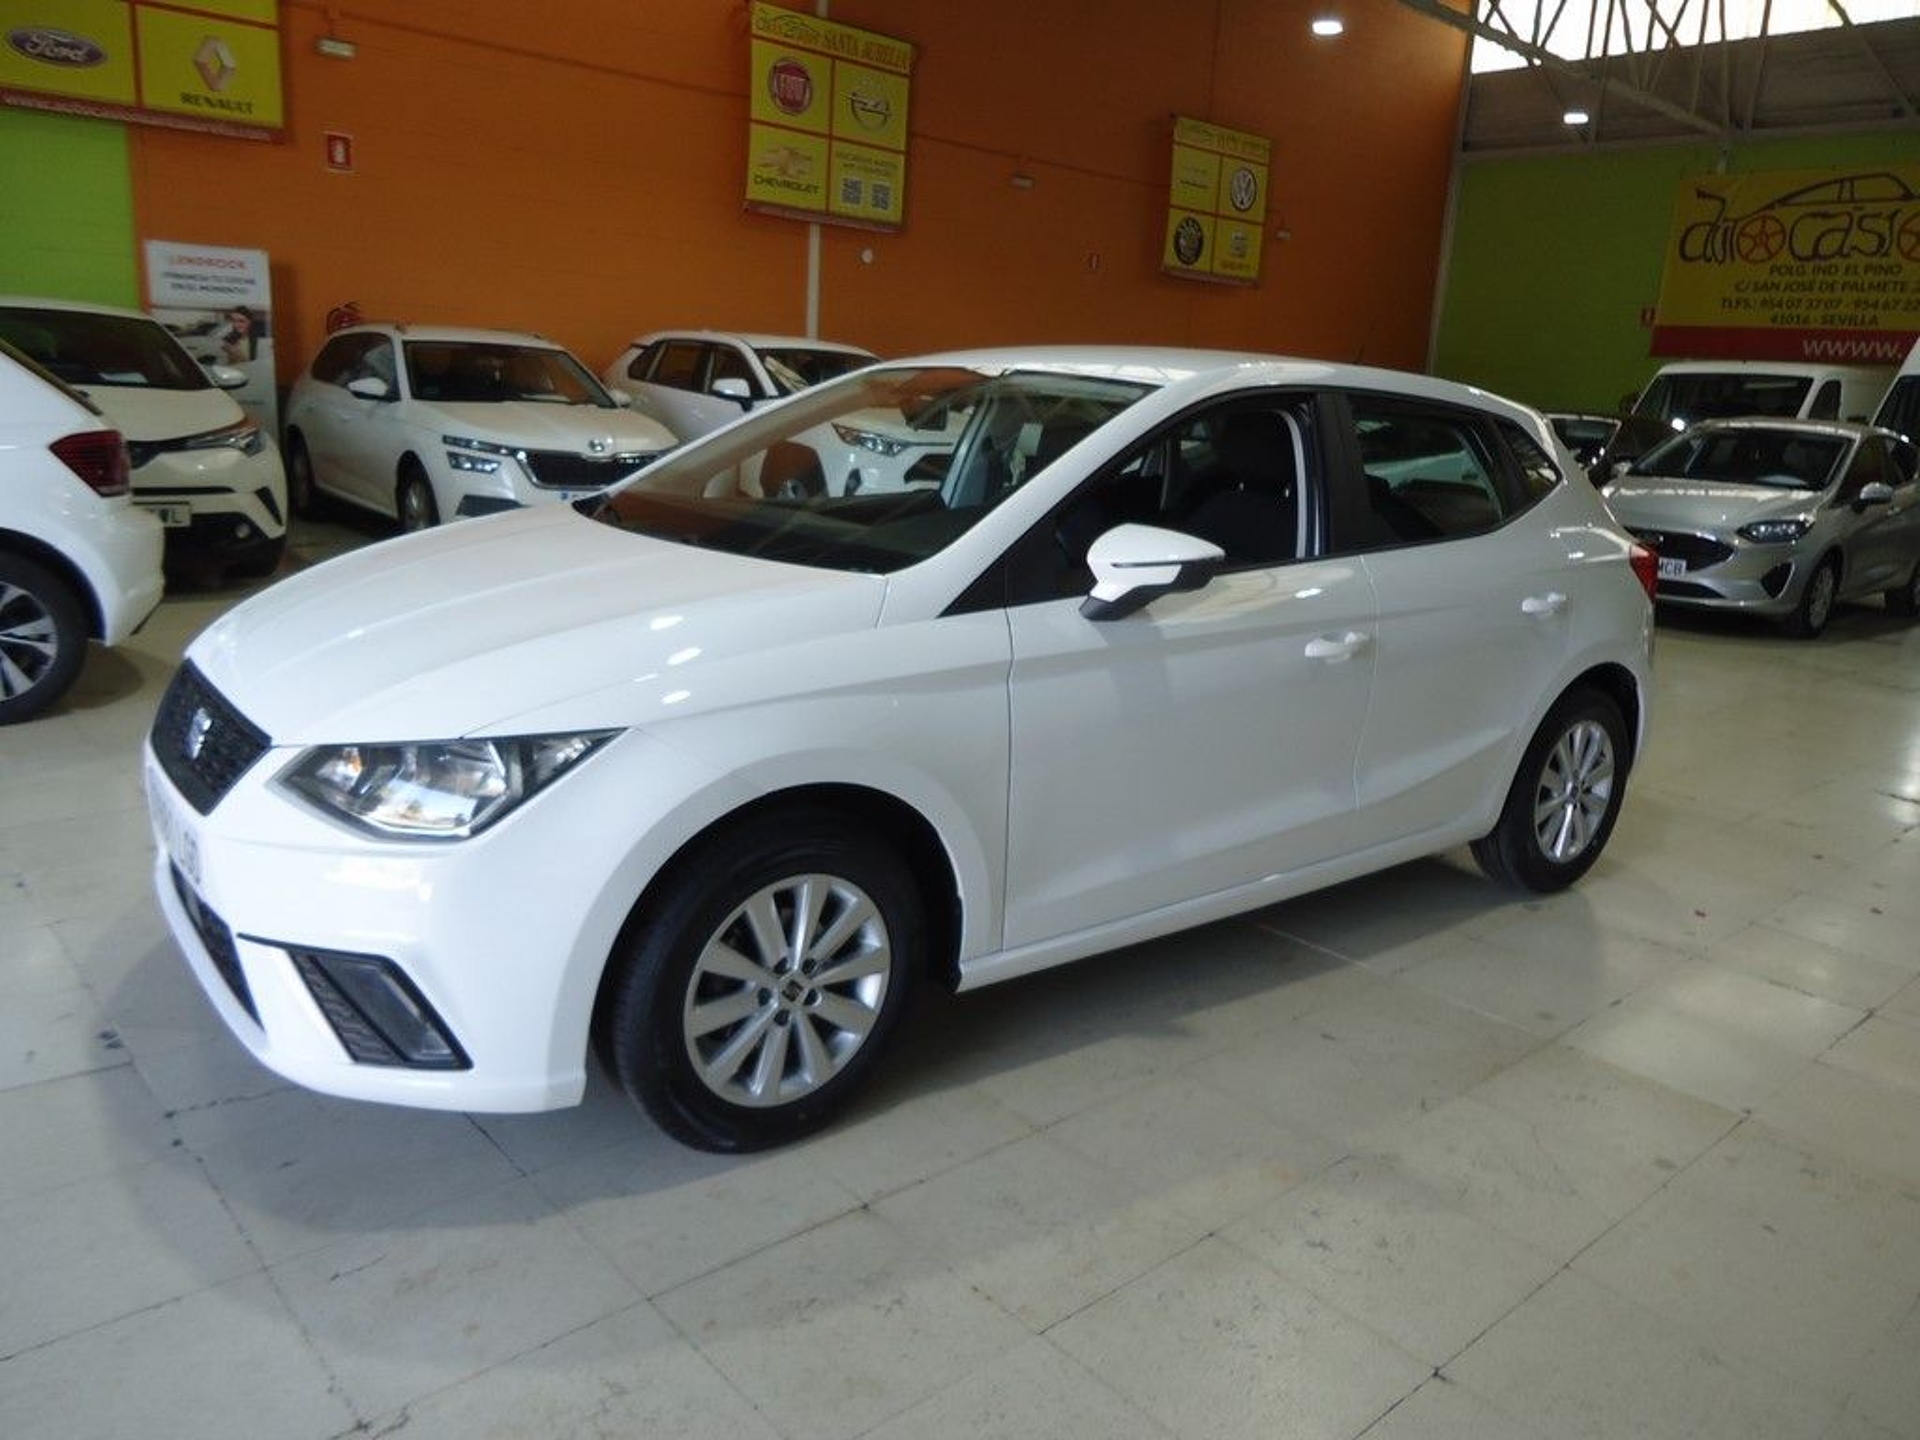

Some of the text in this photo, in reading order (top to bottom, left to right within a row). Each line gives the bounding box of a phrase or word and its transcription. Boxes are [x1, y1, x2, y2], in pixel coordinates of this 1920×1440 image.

[181, 92, 254, 115] RENAULT
[753, 175, 820, 194] CHEVROLET
[1844, 264, 1860, 276] EL
[1863, 264, 1902, 276] PINO
[1752, 280, 1781, 293] SAN
[1818, 280, 1838, 293] DE
[1841, 280, 1907, 293] PALMETE
[1821, 313, 1879, 326] SEVILLA
